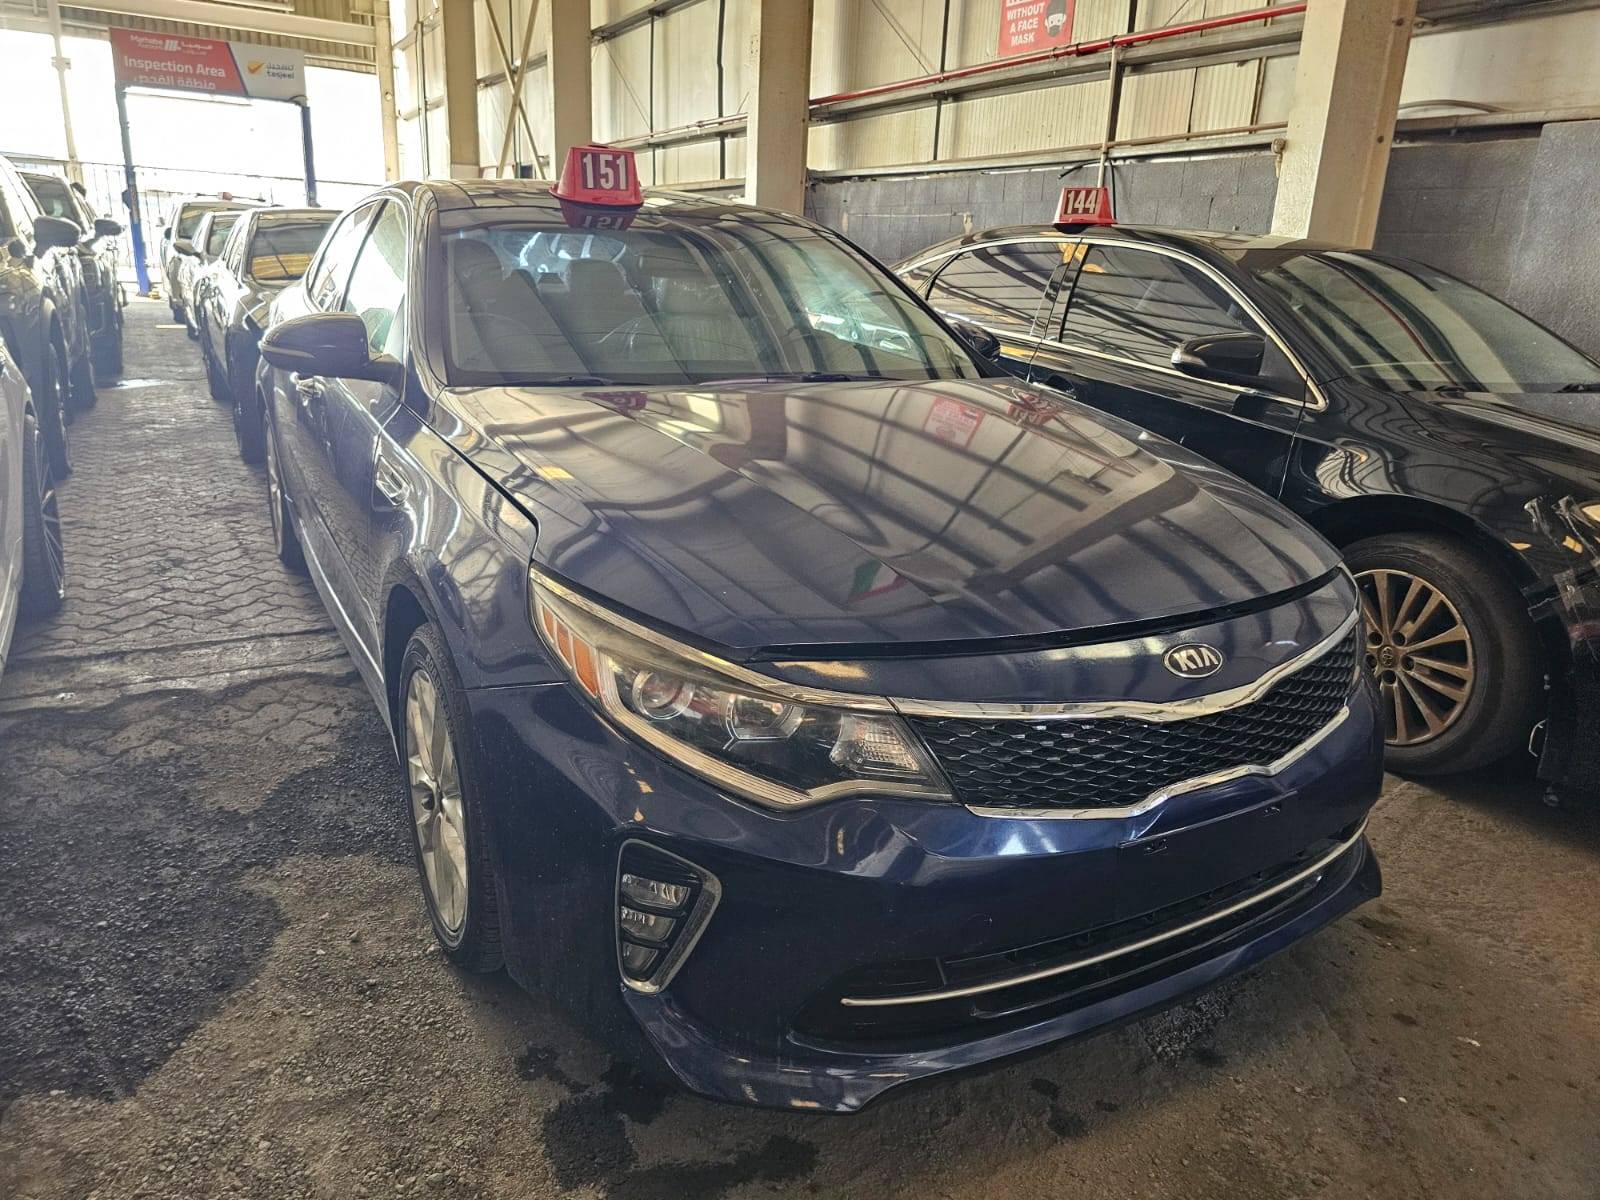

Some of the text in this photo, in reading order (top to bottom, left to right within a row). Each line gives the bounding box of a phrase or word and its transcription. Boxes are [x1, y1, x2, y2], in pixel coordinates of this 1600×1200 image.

[1007, 2, 1045, 21] WITHOUT
[1010, 17, 1039, 33] A FACE
[1011, 32, 1035, 46] MASK
[124, 55, 226, 78] Inspection Area
[582, 152, 627, 191] 151
[1066, 190, 1098, 214] 144
[1171, 647, 1219, 671] KIA
